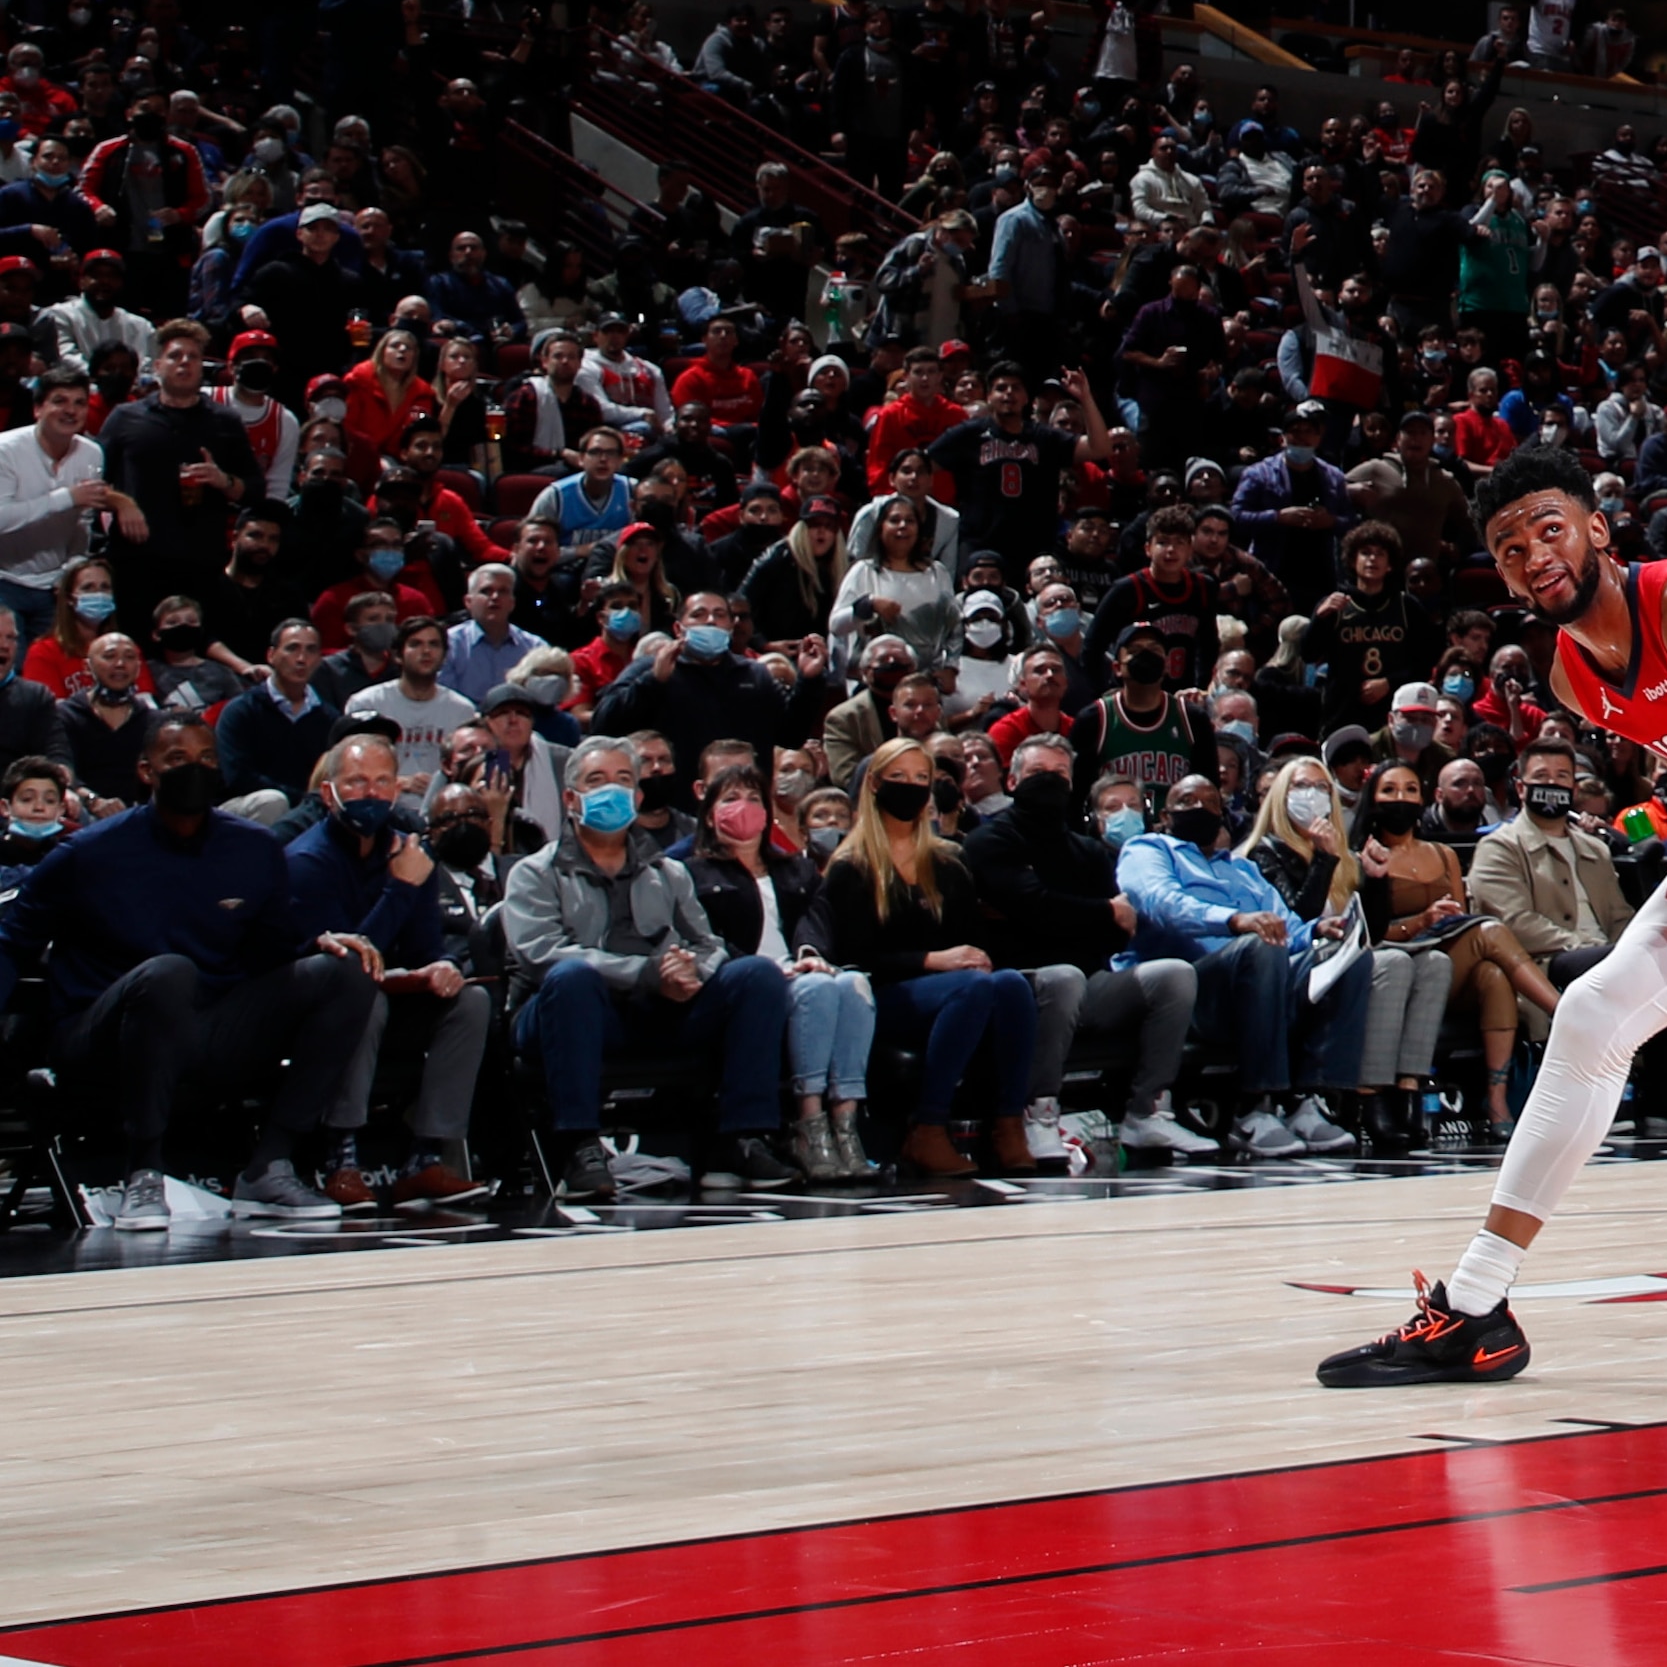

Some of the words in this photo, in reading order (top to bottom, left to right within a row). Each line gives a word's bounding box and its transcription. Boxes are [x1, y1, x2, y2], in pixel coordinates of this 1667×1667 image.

[1552, 19, 1564, 35] 2
[1001, 462, 1023, 498] 8
[1339, 626, 1405, 643] CHICAGO
[1363, 647, 1383, 677] 8
